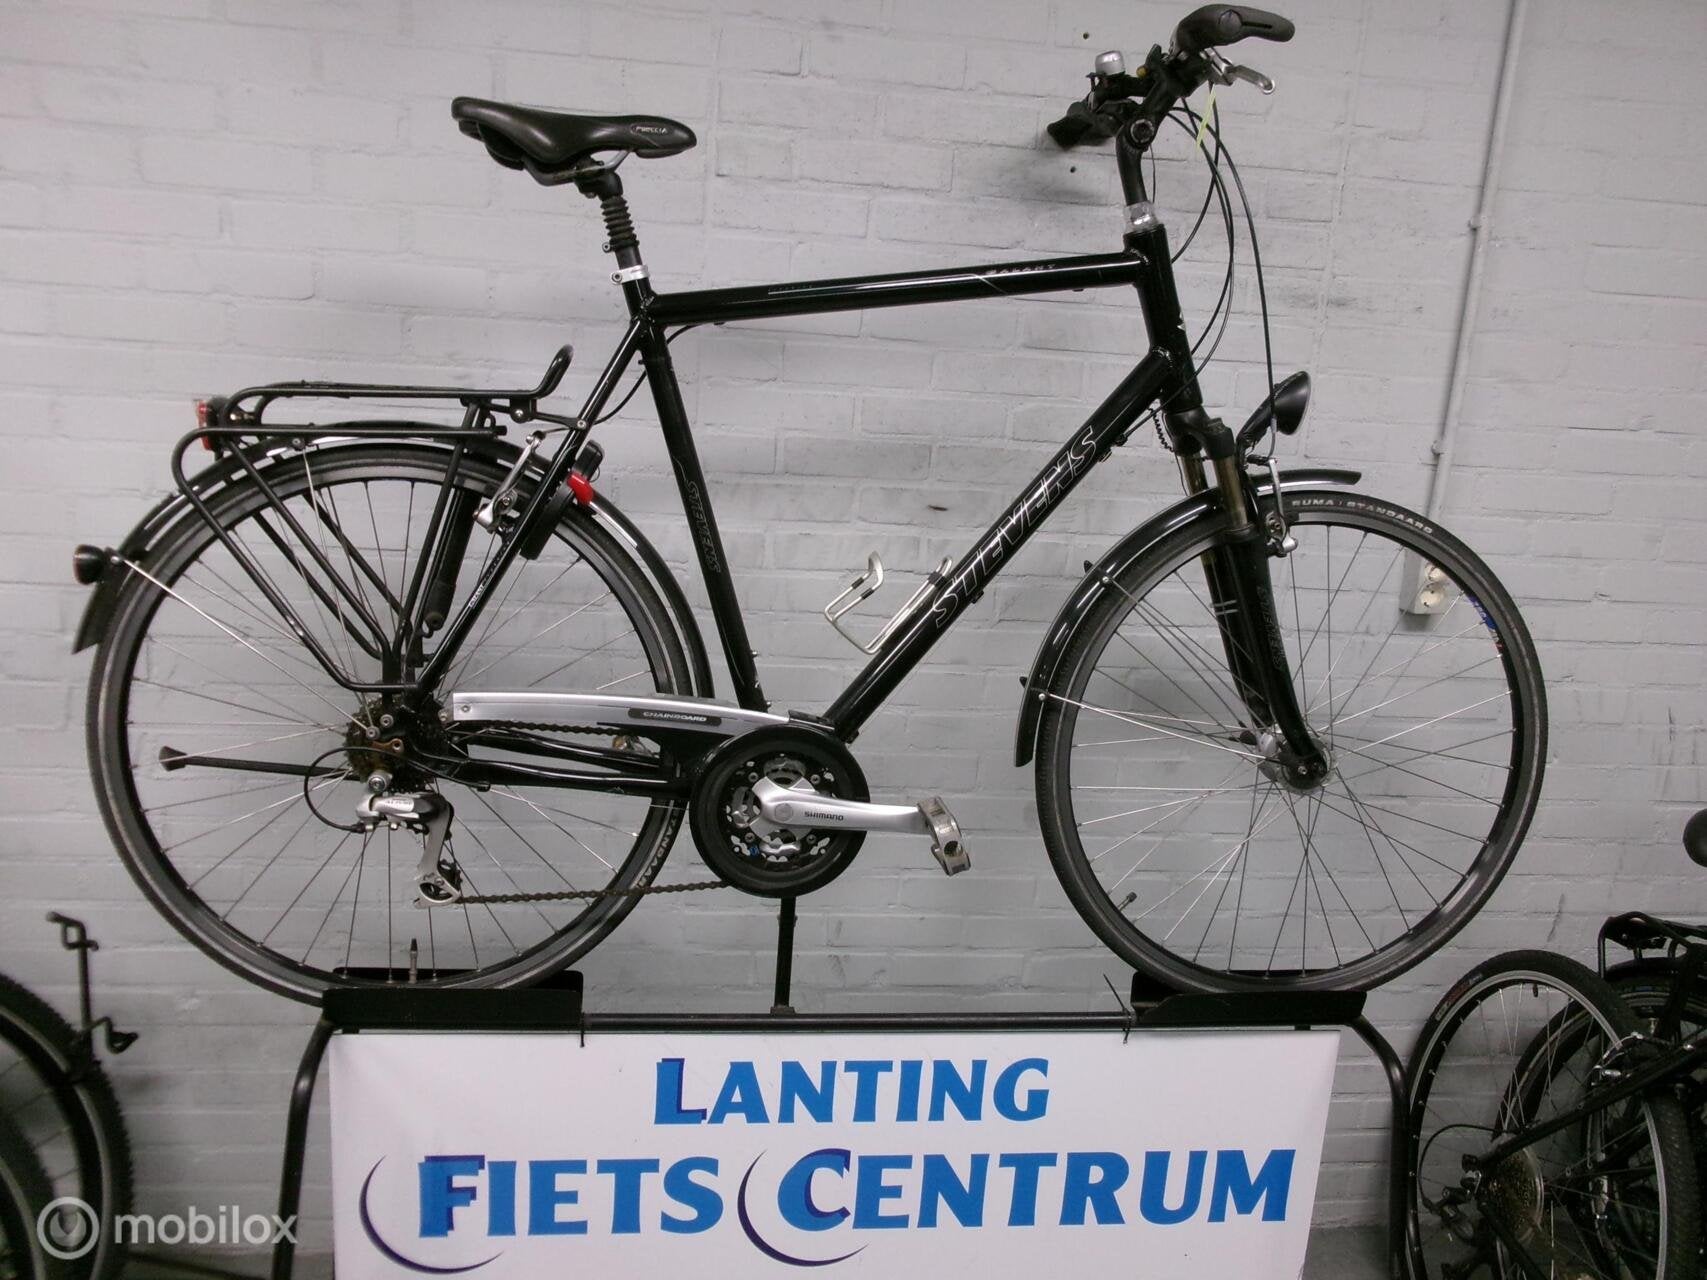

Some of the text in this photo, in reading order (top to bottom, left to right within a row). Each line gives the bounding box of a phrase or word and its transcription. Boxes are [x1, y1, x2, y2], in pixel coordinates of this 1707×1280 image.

[933, 425, 1096, 628] STEVENS
[804, 811, 844, 821] SHIMANO
[654, 1058, 1050, 1125] LANTING
[418, 1148, 1297, 1238] FIETS CENTRUM
